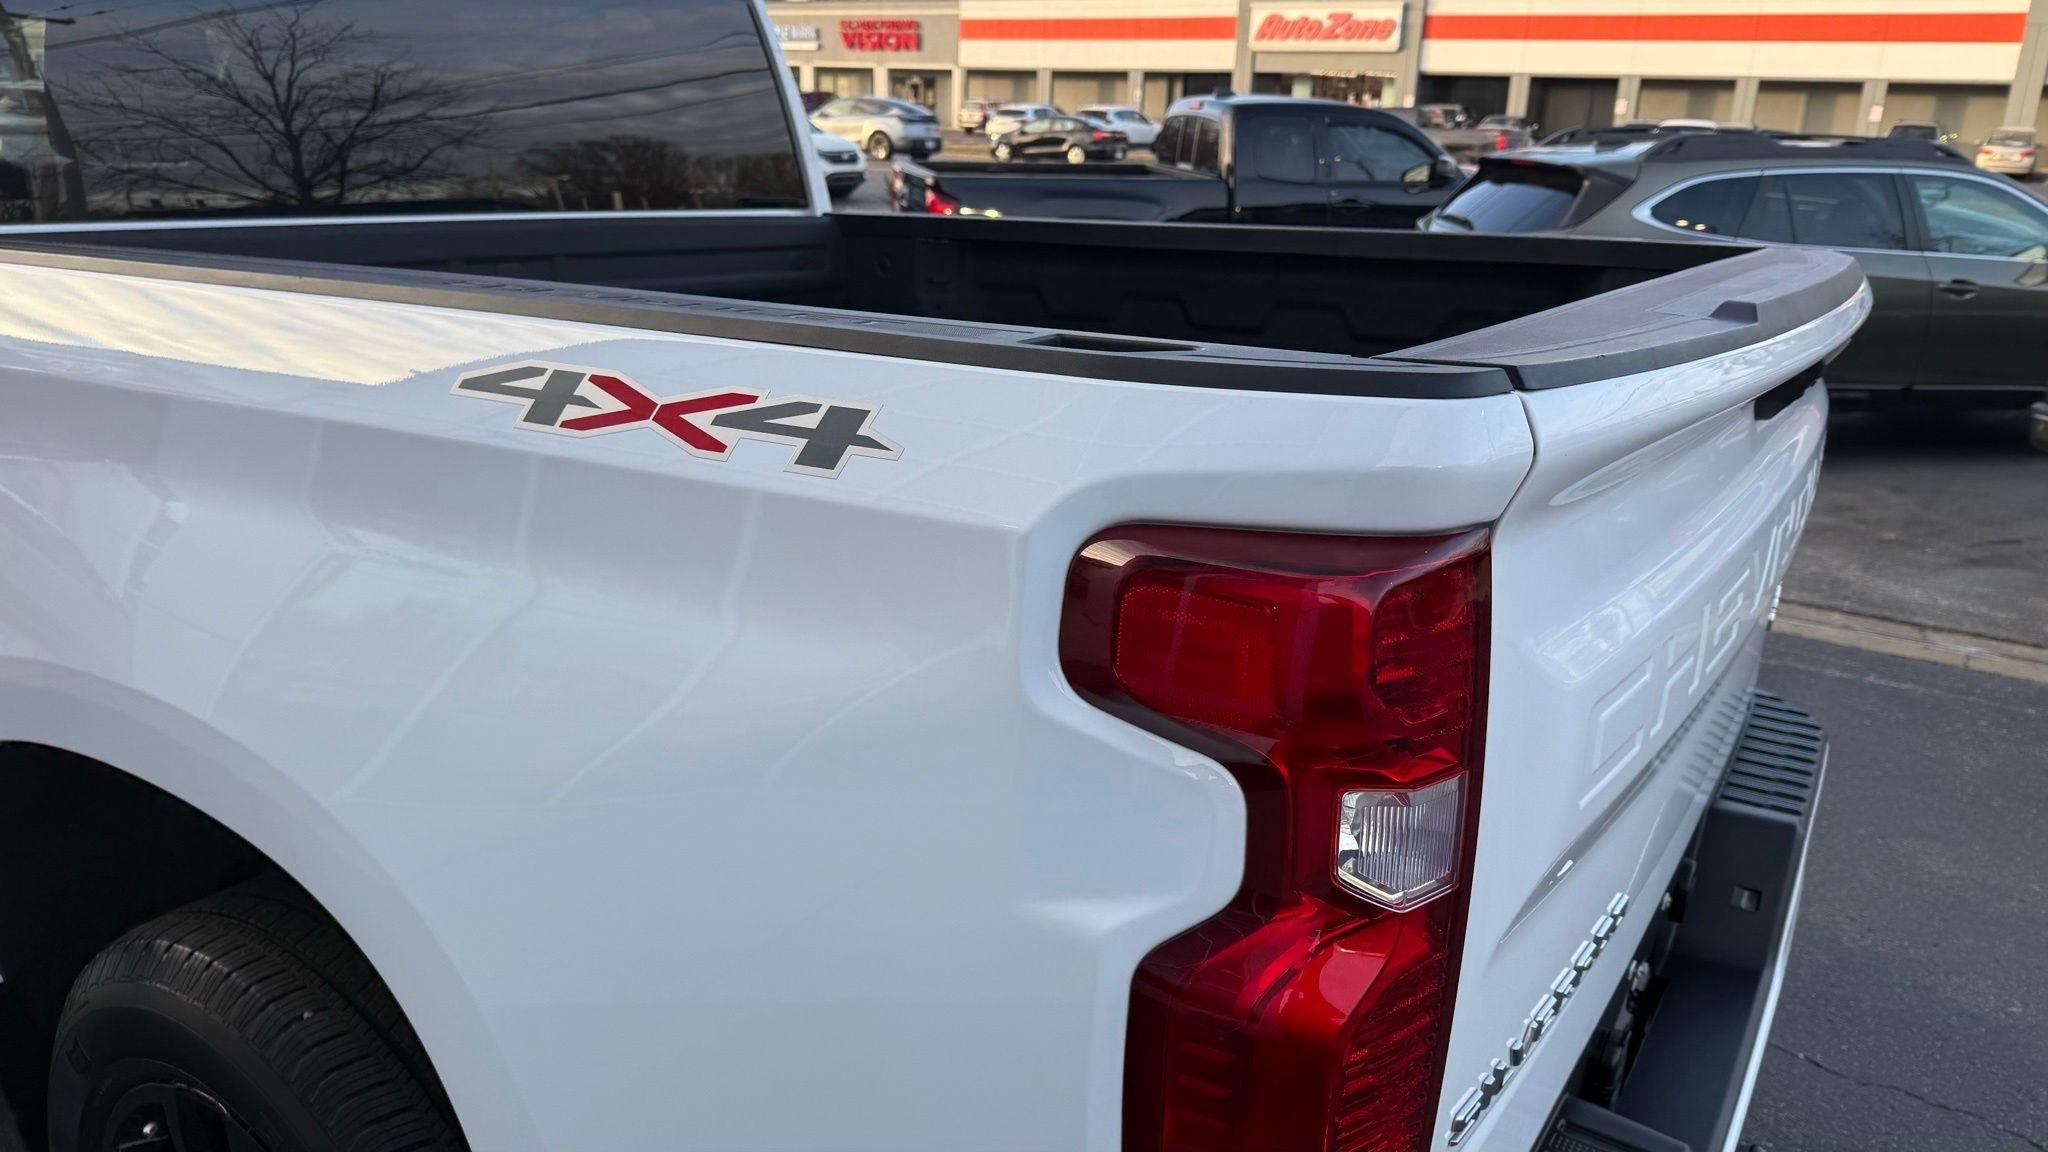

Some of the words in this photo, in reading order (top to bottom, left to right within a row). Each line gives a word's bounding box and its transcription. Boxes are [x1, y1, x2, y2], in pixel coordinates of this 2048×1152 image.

[1254, 13, 1397, 41] AutoZone
[842, 32, 920, 52] VISION
[1576, 455, 1823, 811] CHEVRO
